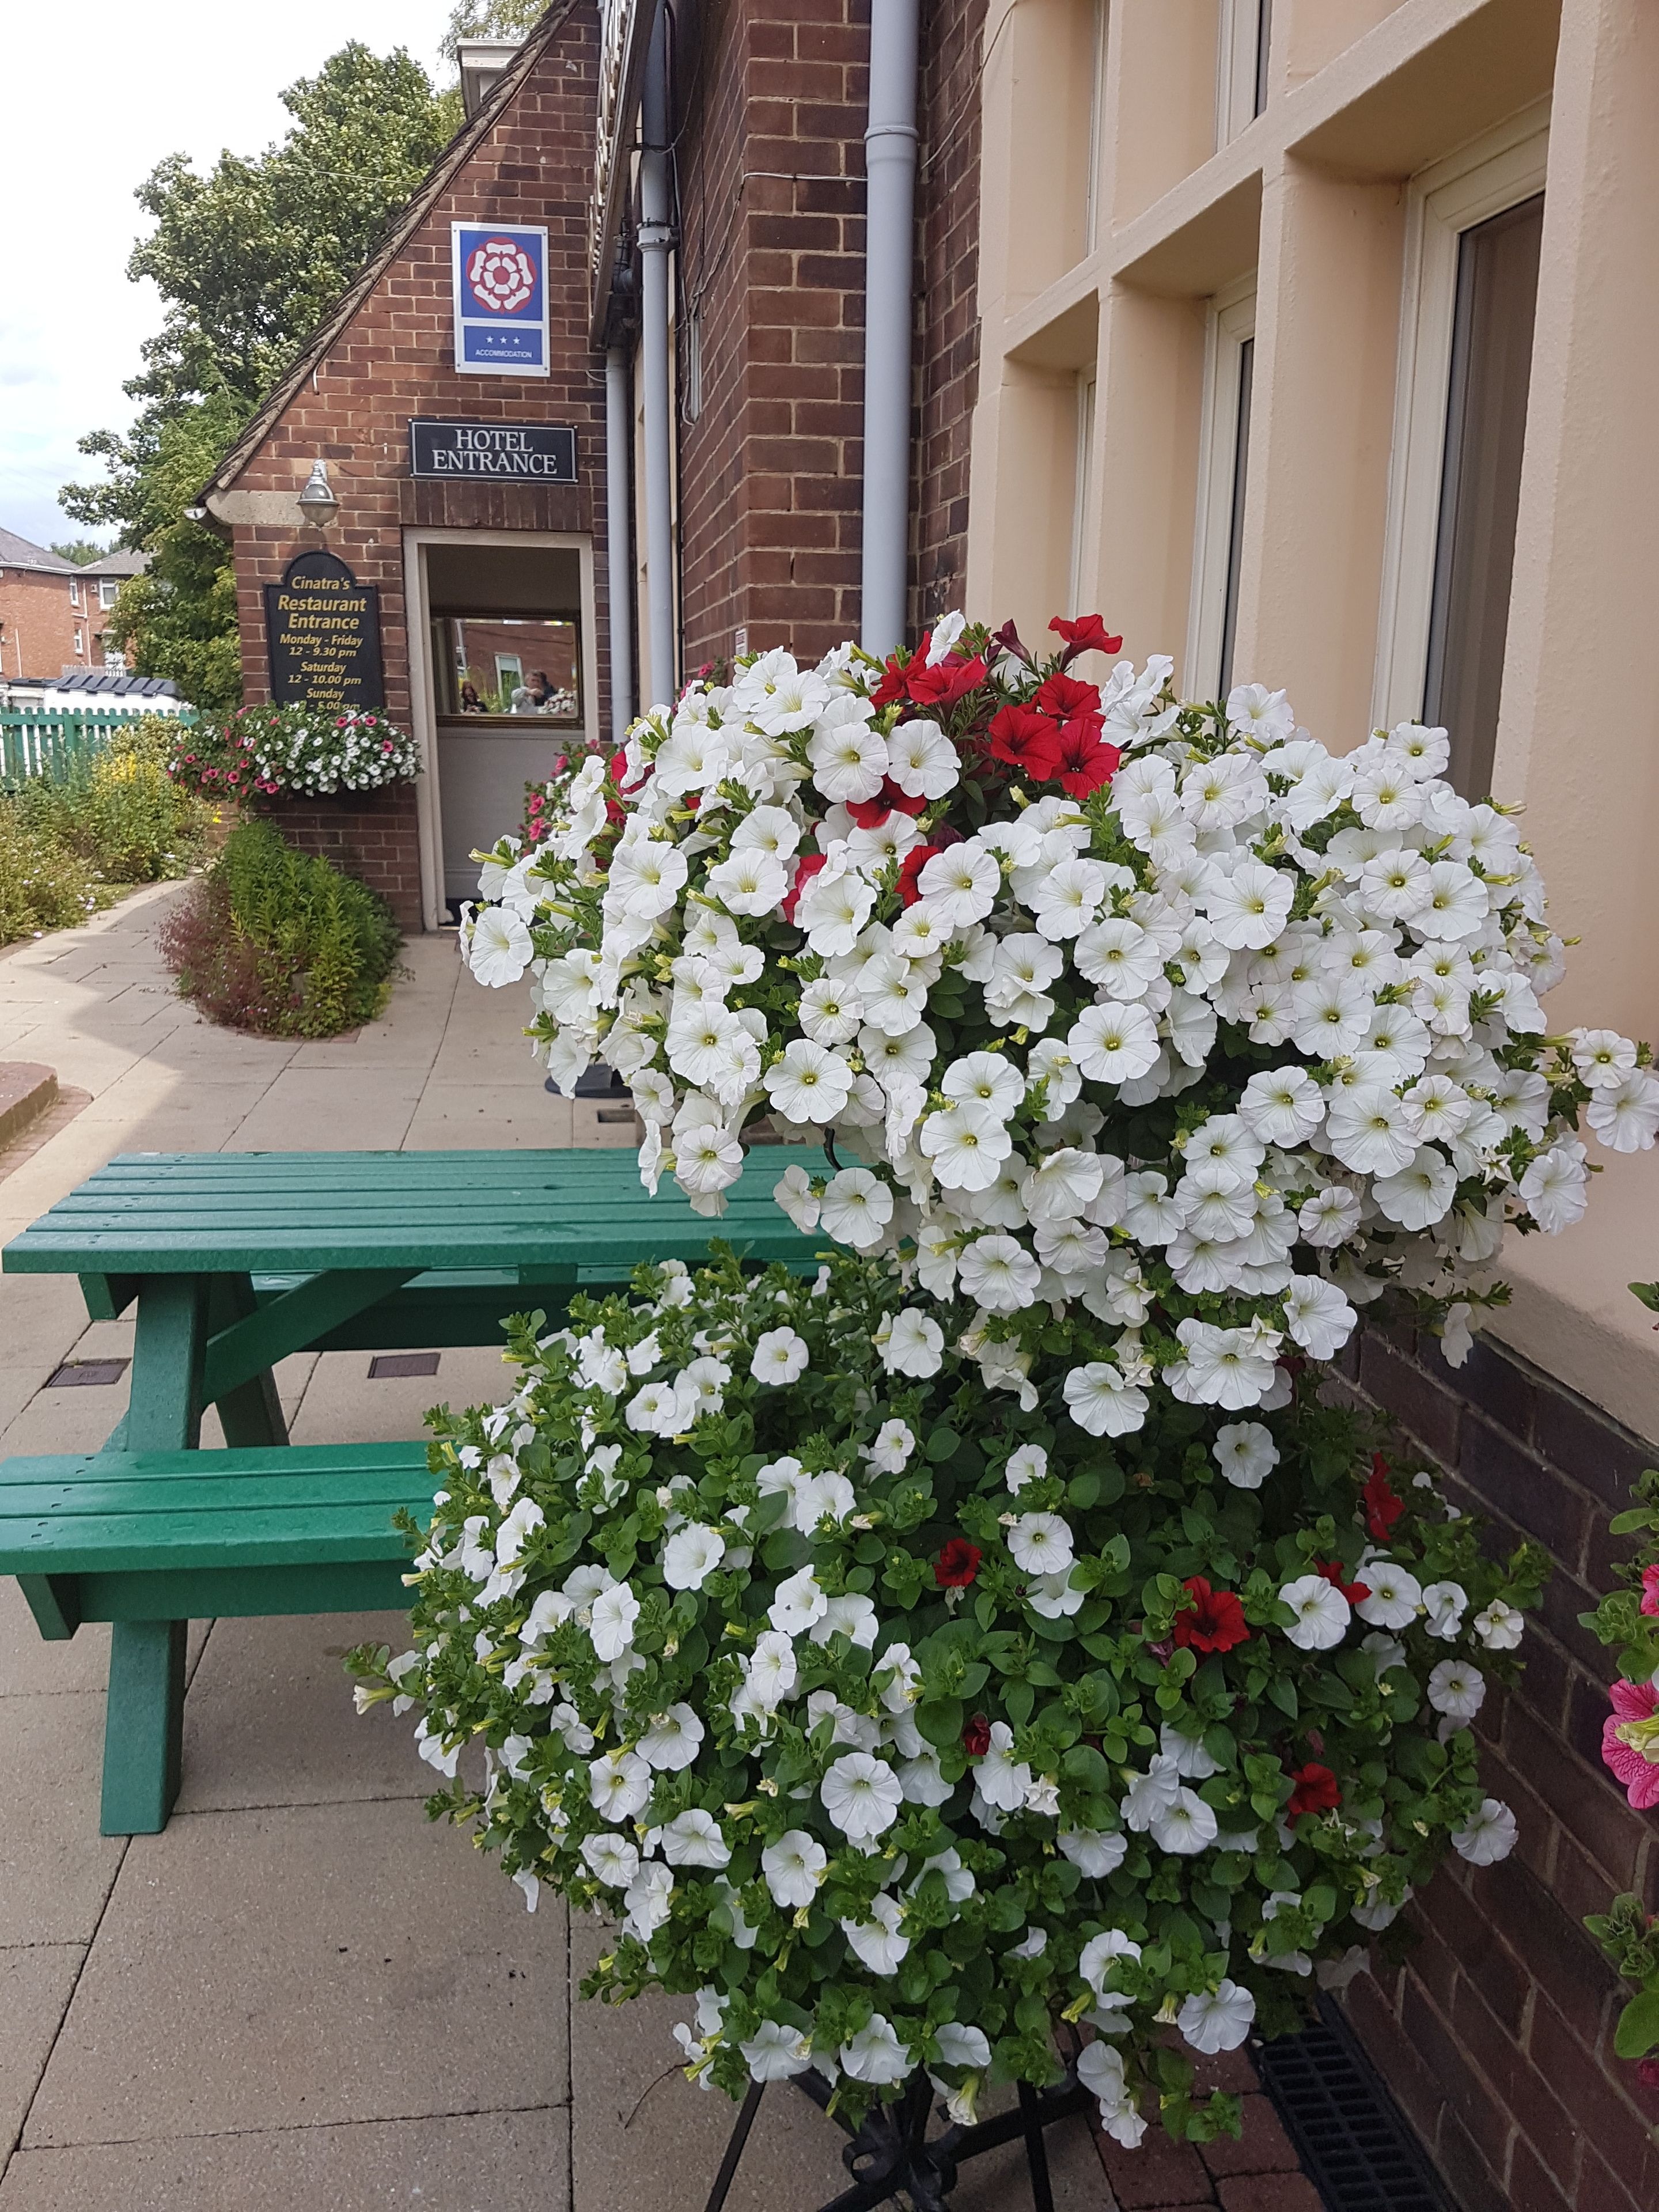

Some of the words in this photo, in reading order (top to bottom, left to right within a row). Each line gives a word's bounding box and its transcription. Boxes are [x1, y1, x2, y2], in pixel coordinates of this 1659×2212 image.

[475, 349, 532, 358] ACCOMMODATION
[455, 429, 533, 452] HOTEL
[432, 450, 558, 474] ENTRANCE
[291, 576, 350, 590] Cinatra's
[278, 594, 367, 612] Restaurant
[289, 613, 359, 630] Entrance
[279, 634, 323, 647] Monday
[331, 634, 363, 648] Friday
[289, 646, 304, 656] 12
[313, 647, 336, 656] 9.30
[338, 649, 357, 658] pm
[300, 661, 347, 675] Saturday
[288, 674, 302, 684] 12
[312, 675, 342, 684] 10.00
[343, 677, 362, 687] pm
[306, 688, 345, 701] Sunday
